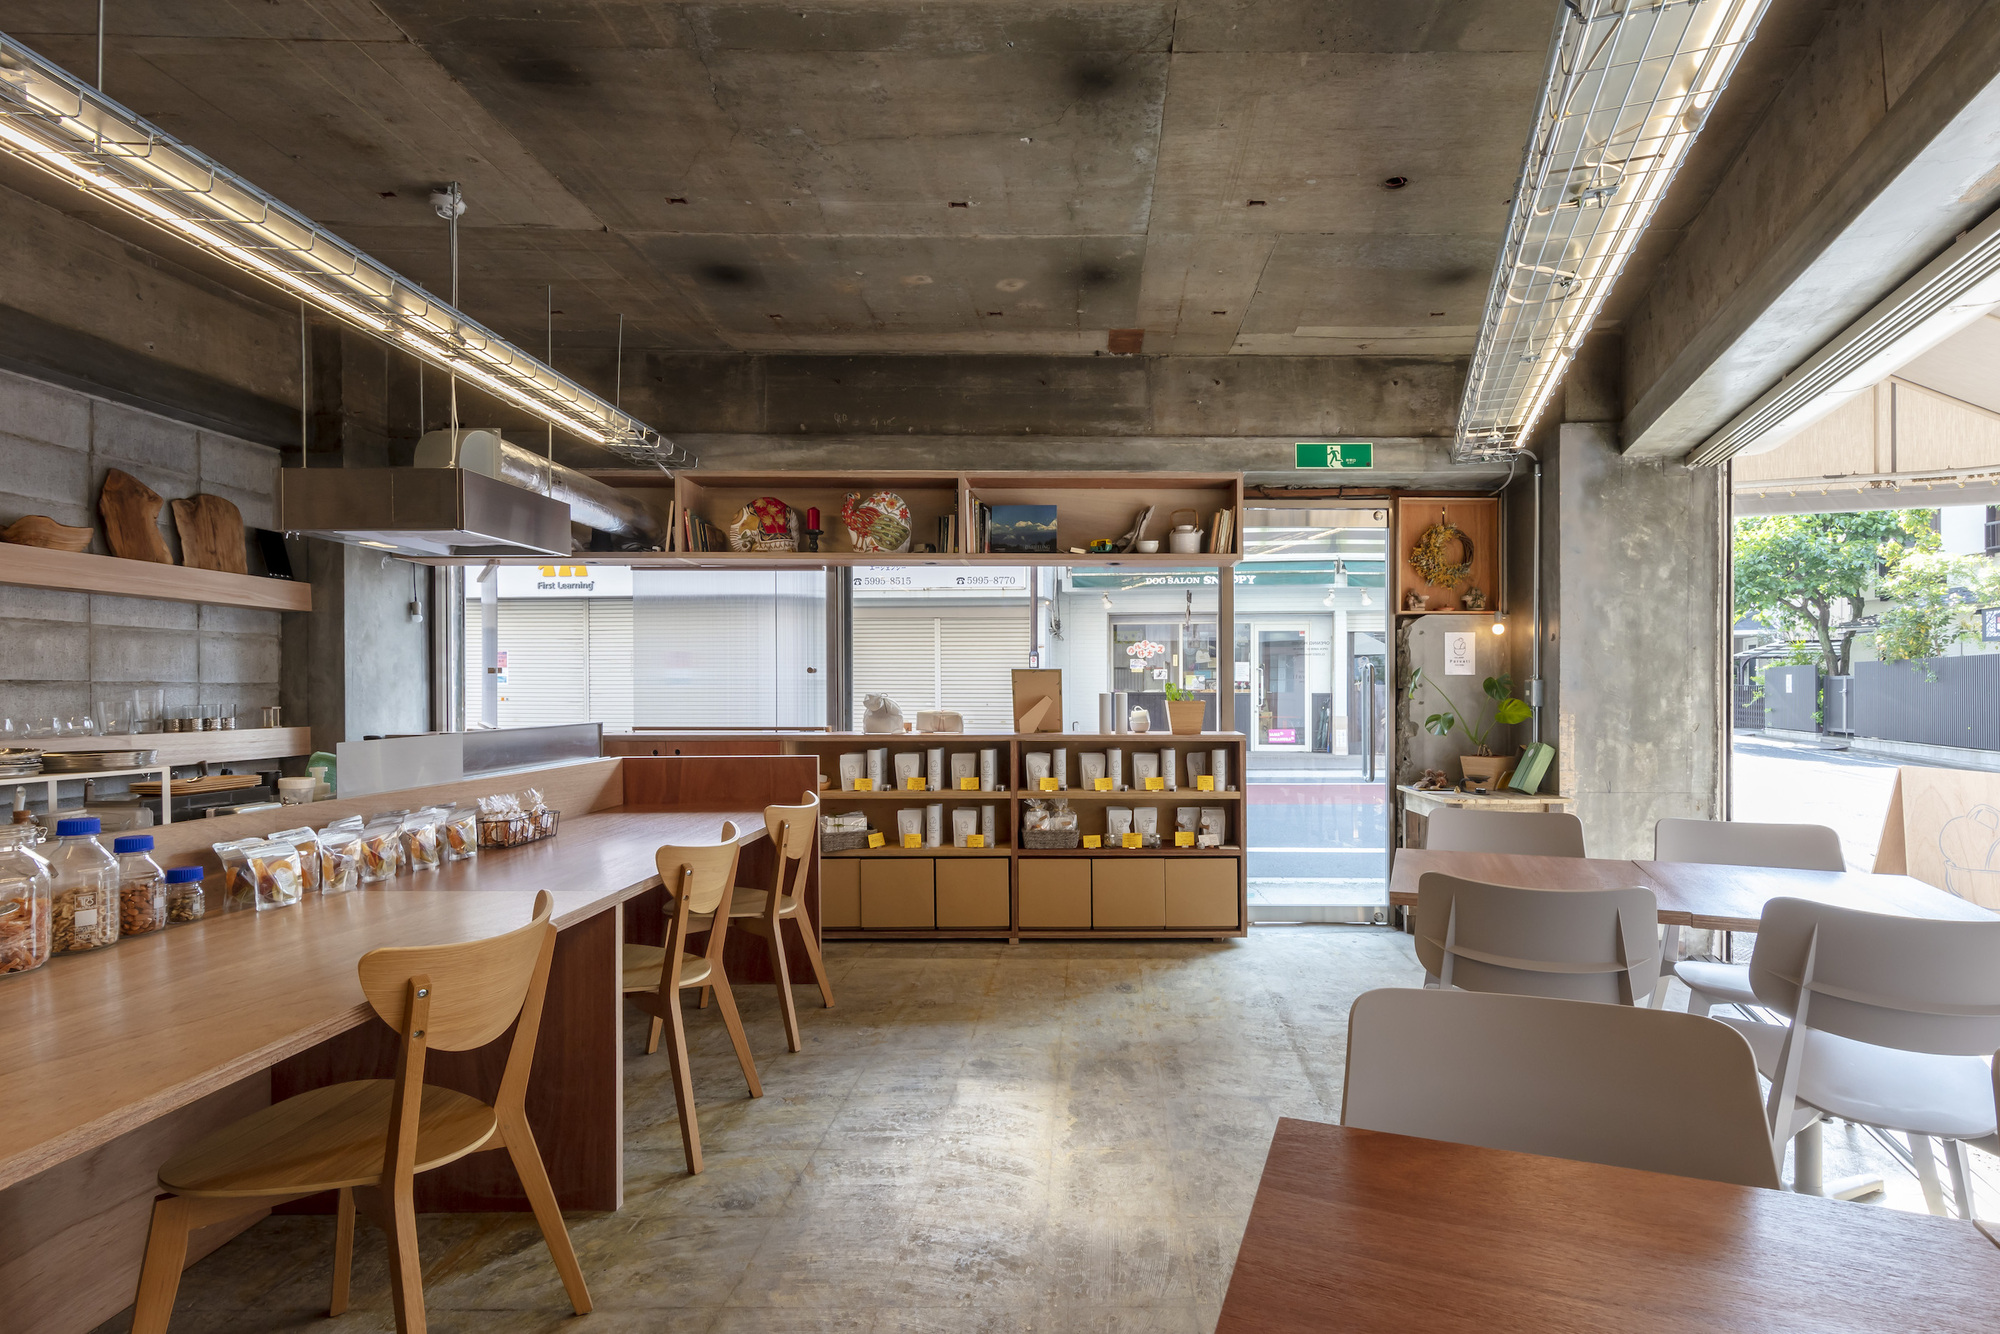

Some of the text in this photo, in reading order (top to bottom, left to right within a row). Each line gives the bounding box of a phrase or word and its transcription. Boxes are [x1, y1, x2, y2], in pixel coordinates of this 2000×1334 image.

[864, 576, 911, 586] 5995-8515
[966, 575, 1016, 585] 5995-8770
[1145, 577, 1166, 585] DOG
[1167, 576, 1200, 584] SALON
[537, 580, 594, 591] First Learning
